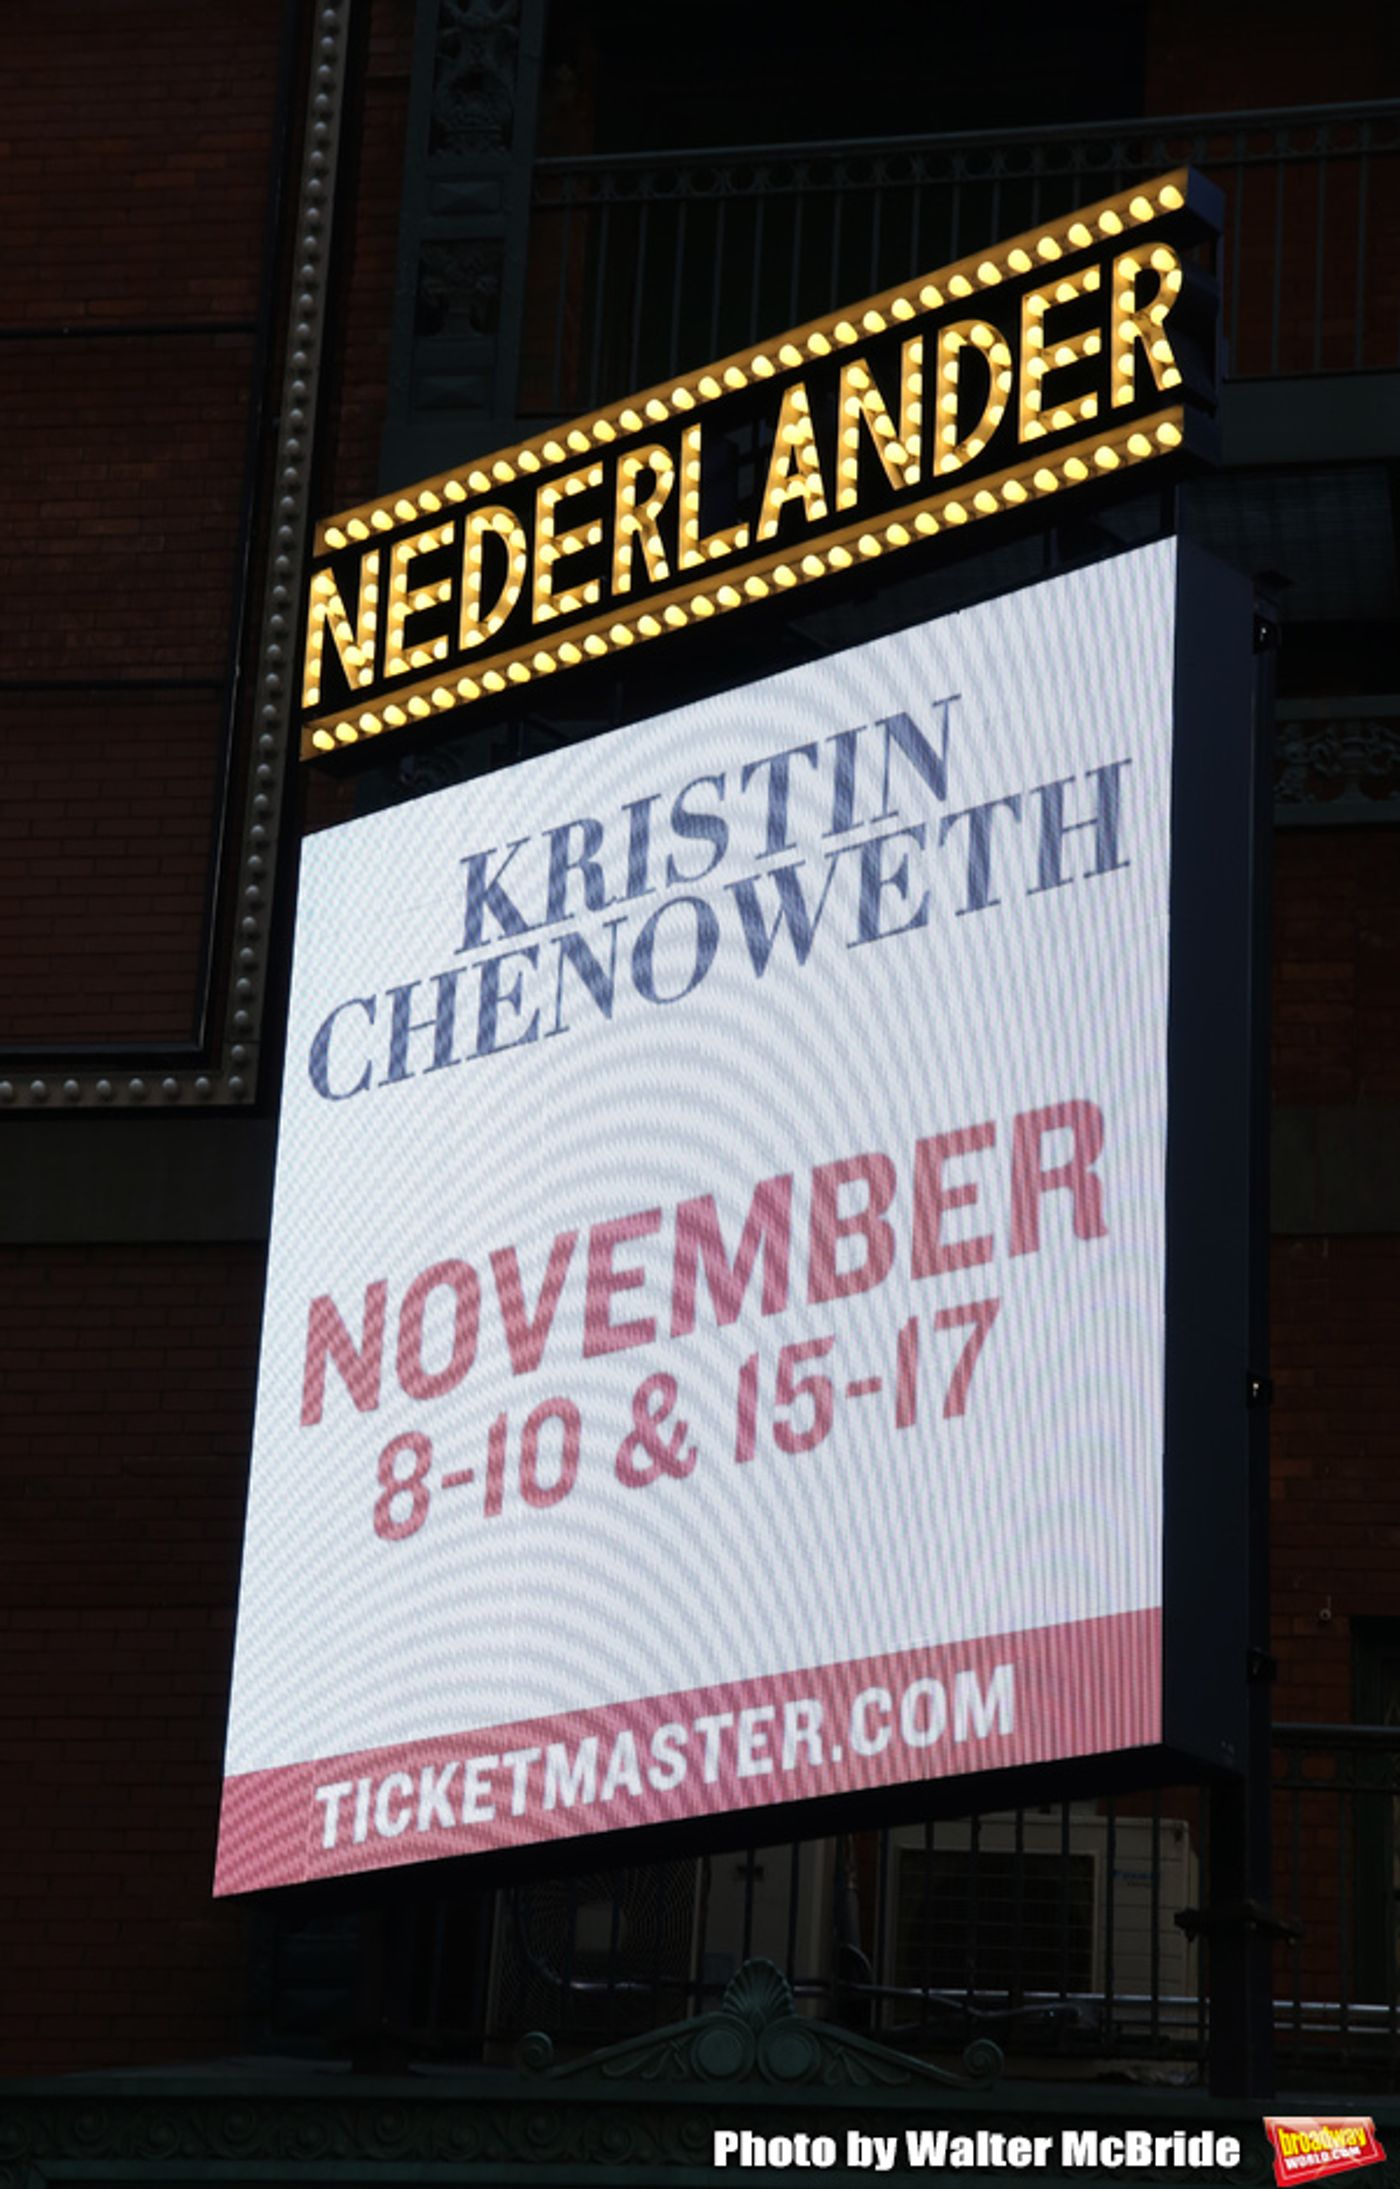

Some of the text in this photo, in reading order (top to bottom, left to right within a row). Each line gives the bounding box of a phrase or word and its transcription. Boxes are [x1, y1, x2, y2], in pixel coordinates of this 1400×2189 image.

[302, 243, 1182, 710] NEDERLANDER
[308, 759, 1132, 1102] CHENOWETH
[453, 693, 963, 955] KRISTIN
[300, 1098, 1109, 1427] NOVEMBER
[373, 1297, 1001, 1542] 8-10 & 15-17
[314, 1664, 1016, 1849] TICKETMASTER.COM
